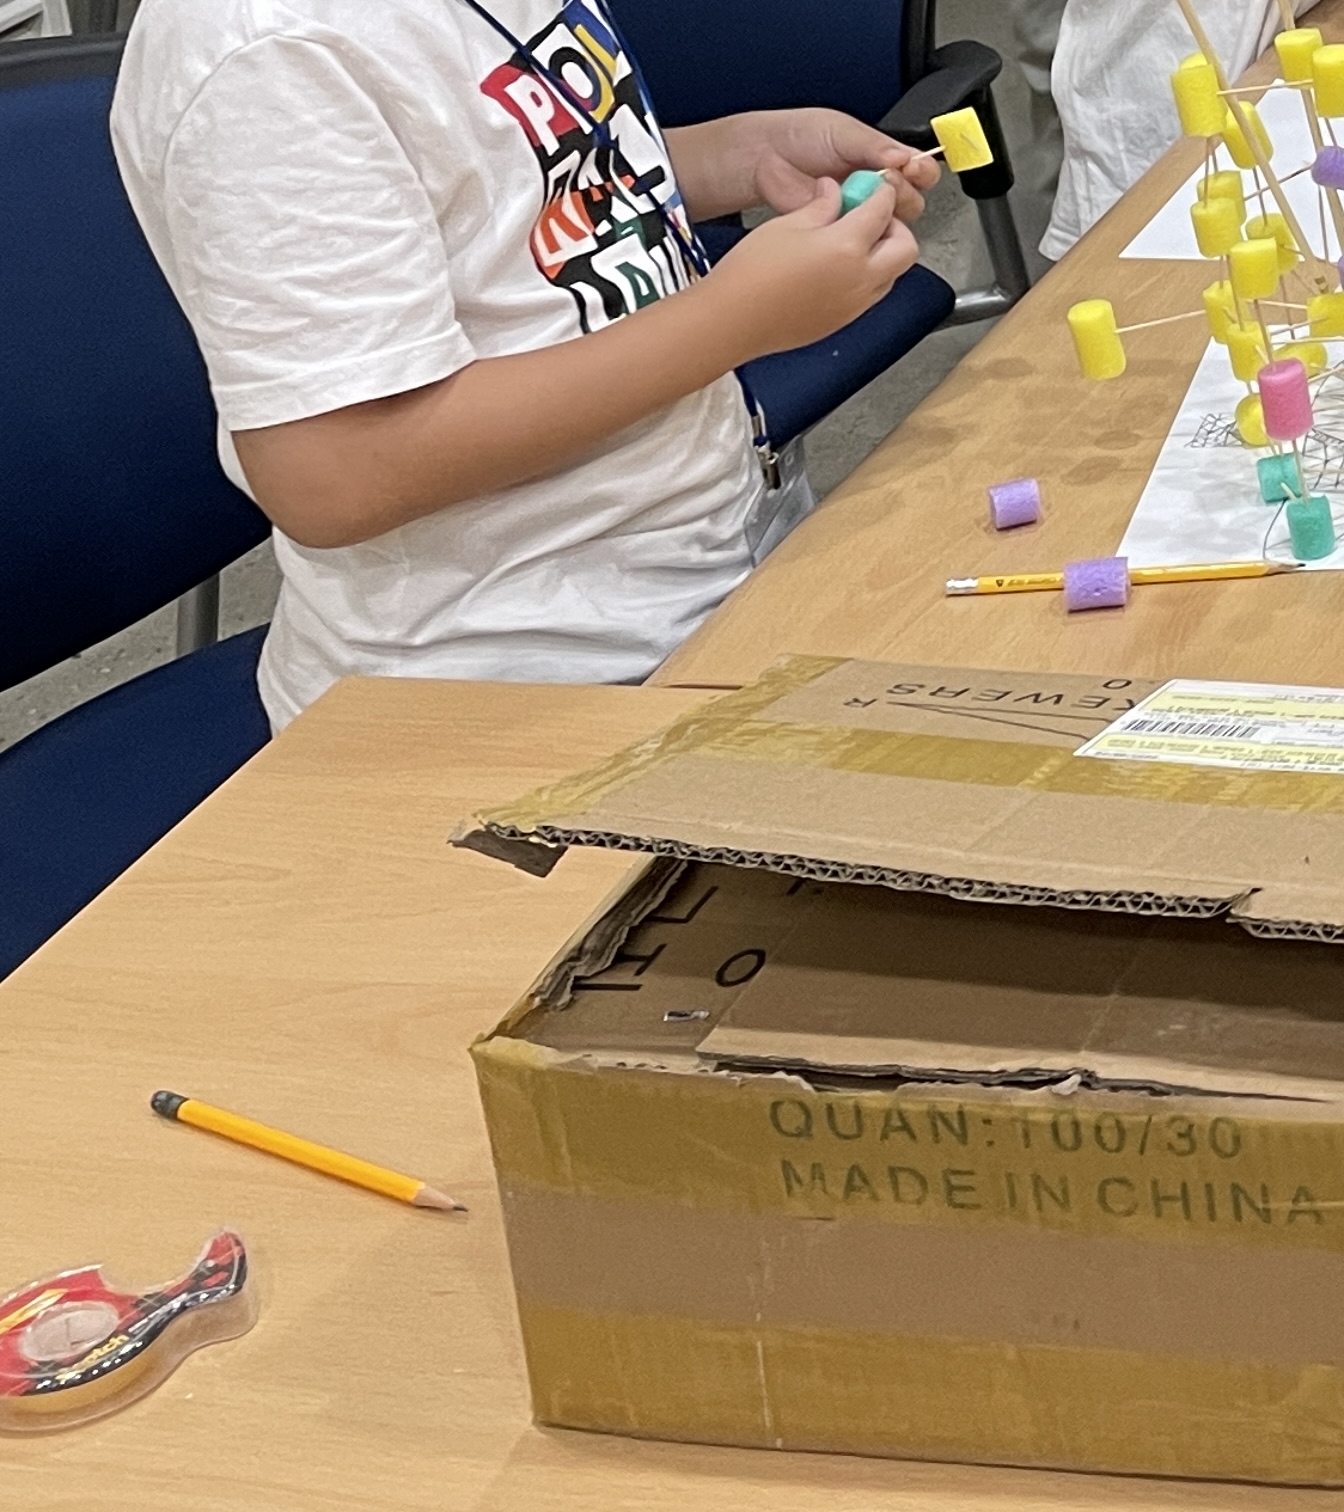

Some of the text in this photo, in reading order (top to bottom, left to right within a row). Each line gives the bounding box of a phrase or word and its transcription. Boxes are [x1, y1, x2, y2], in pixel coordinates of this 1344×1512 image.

[779, 1159, 1329, 1227] MADE IN CHINA
